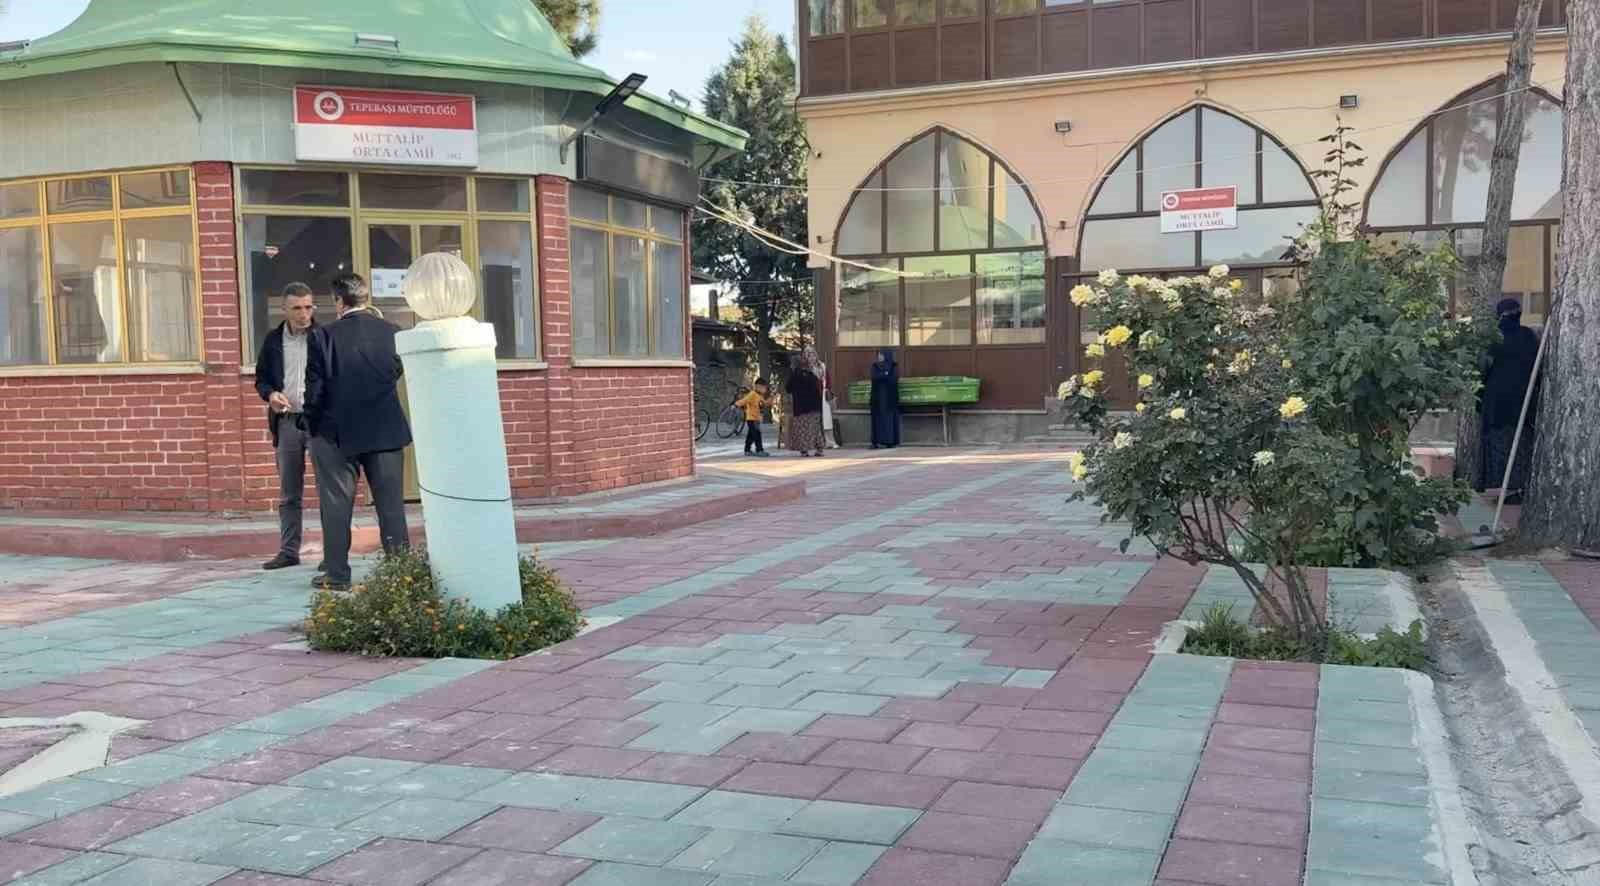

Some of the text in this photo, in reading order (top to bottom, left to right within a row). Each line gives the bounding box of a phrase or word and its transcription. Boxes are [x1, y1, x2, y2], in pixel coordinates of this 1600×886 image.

[350, 103, 457, 116] TEPEBAŞI MÜFTÜLÜĞÜ
[352, 131, 424, 145] MUTTALİP
[352, 146, 391, 158] ORTA
[393, 146, 434, 159] CAMİİ
